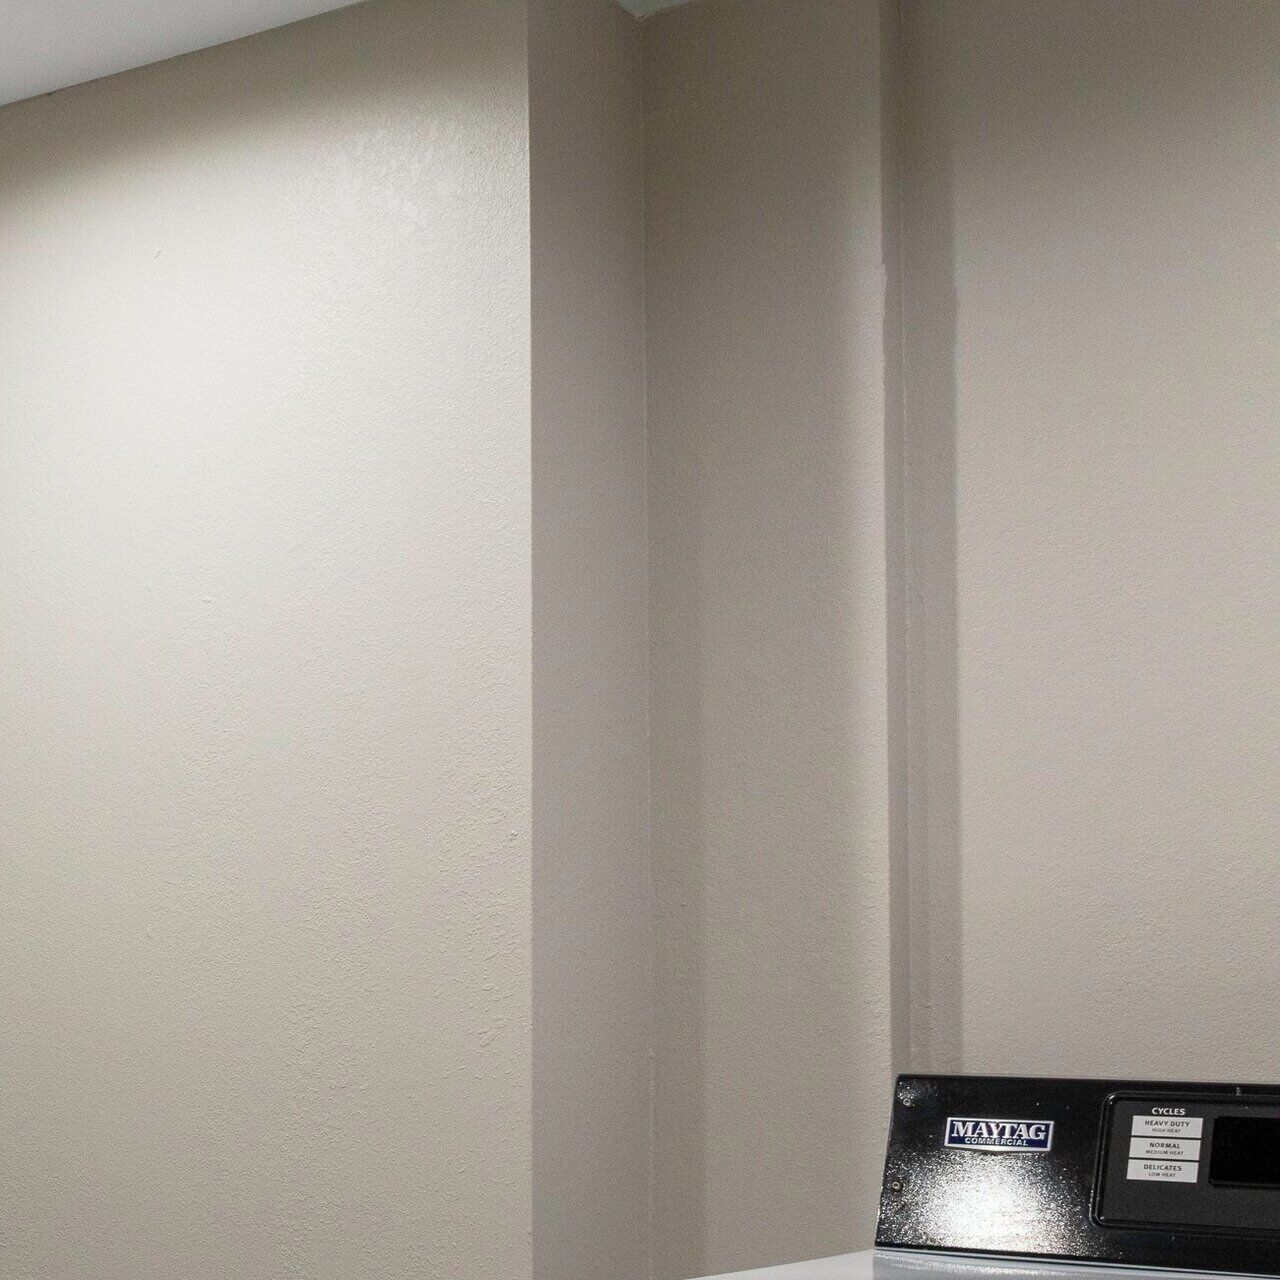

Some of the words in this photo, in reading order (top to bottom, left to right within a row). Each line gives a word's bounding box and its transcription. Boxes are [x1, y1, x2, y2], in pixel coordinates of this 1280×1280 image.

[1152, 1107, 1186, 1116] CYCLES
[950, 1120, 1047, 1140] MAYTAG
[964, 1138, 1028, 1146] COMMERCIAL
[1144, 1164, 1182, 1172] DELICATES
